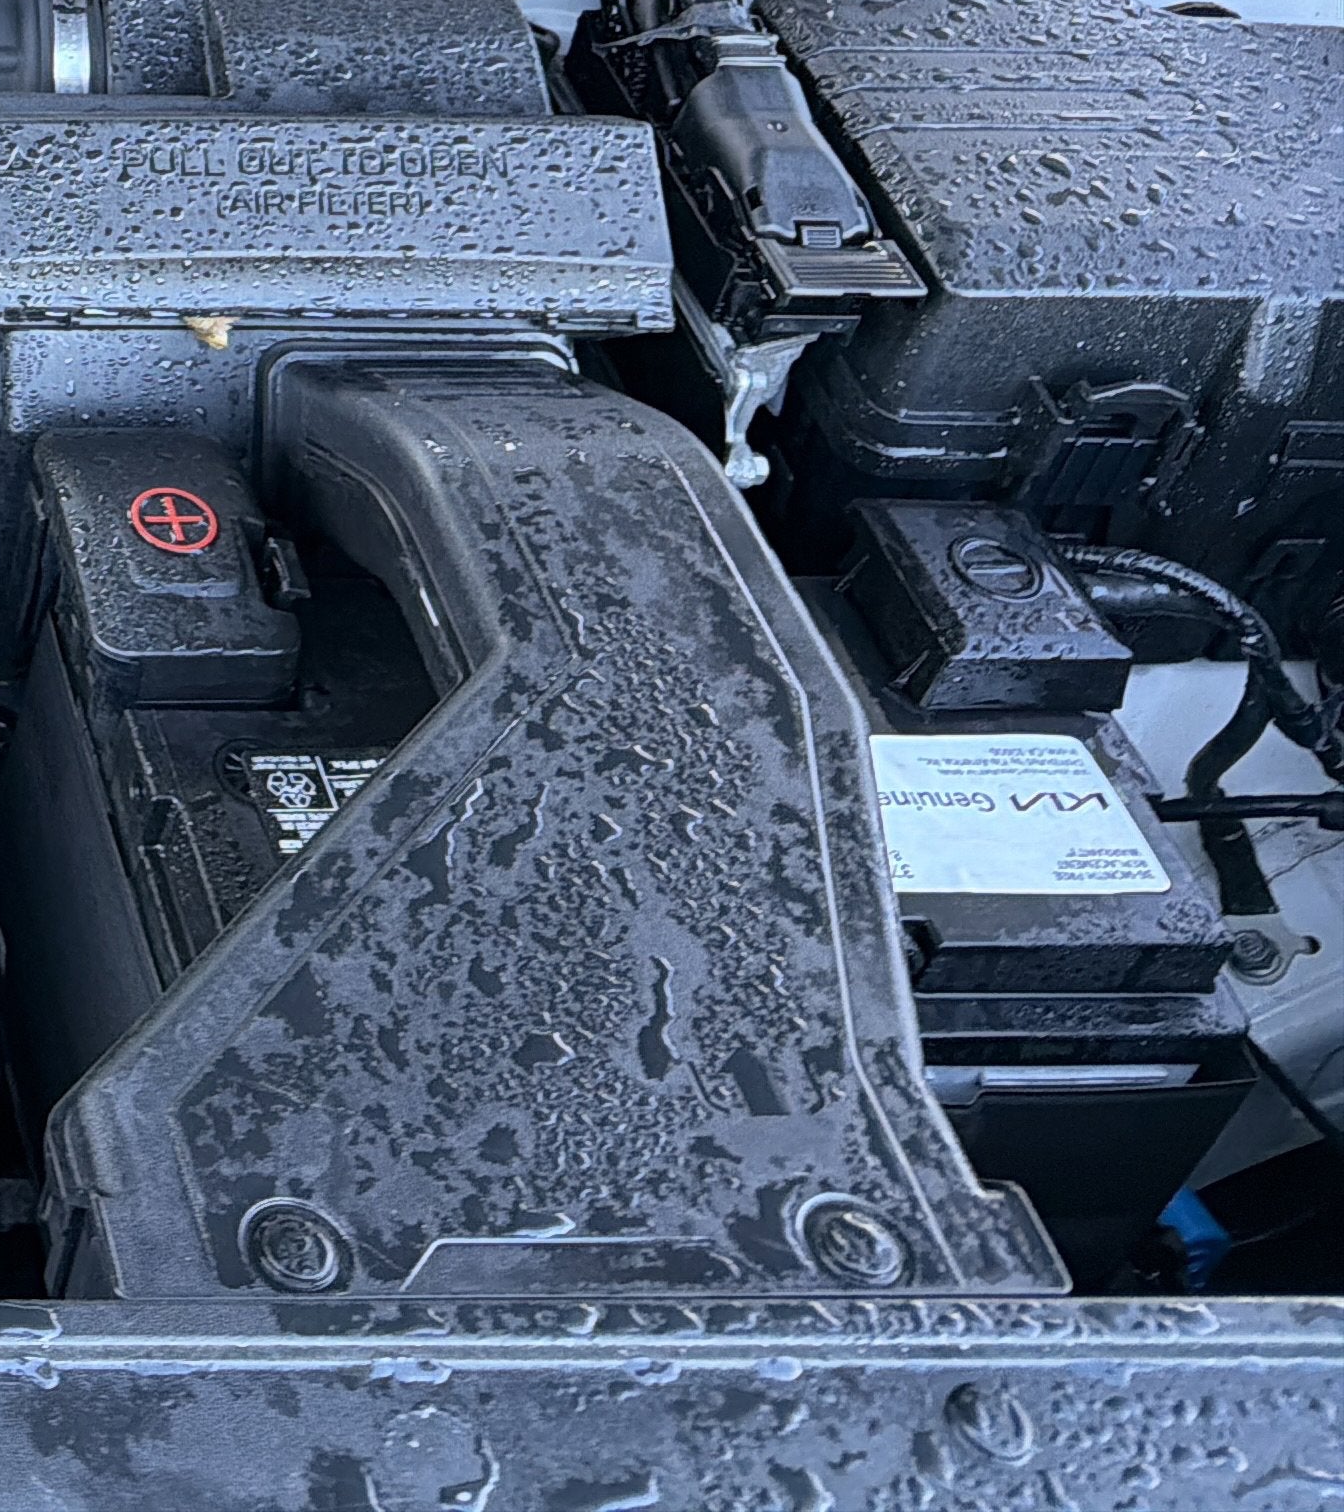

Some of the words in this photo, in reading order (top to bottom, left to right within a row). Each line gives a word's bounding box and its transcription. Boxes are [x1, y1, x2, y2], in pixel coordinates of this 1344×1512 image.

[118, 145, 226, 178] PULL
[237, 146, 316, 177] OUT
[340, 147, 388, 176] TO
[400, 146, 510, 179] OPEN
[876, 791, 996, 813] Genuine
[1009, 791, 1110, 813] KIA
